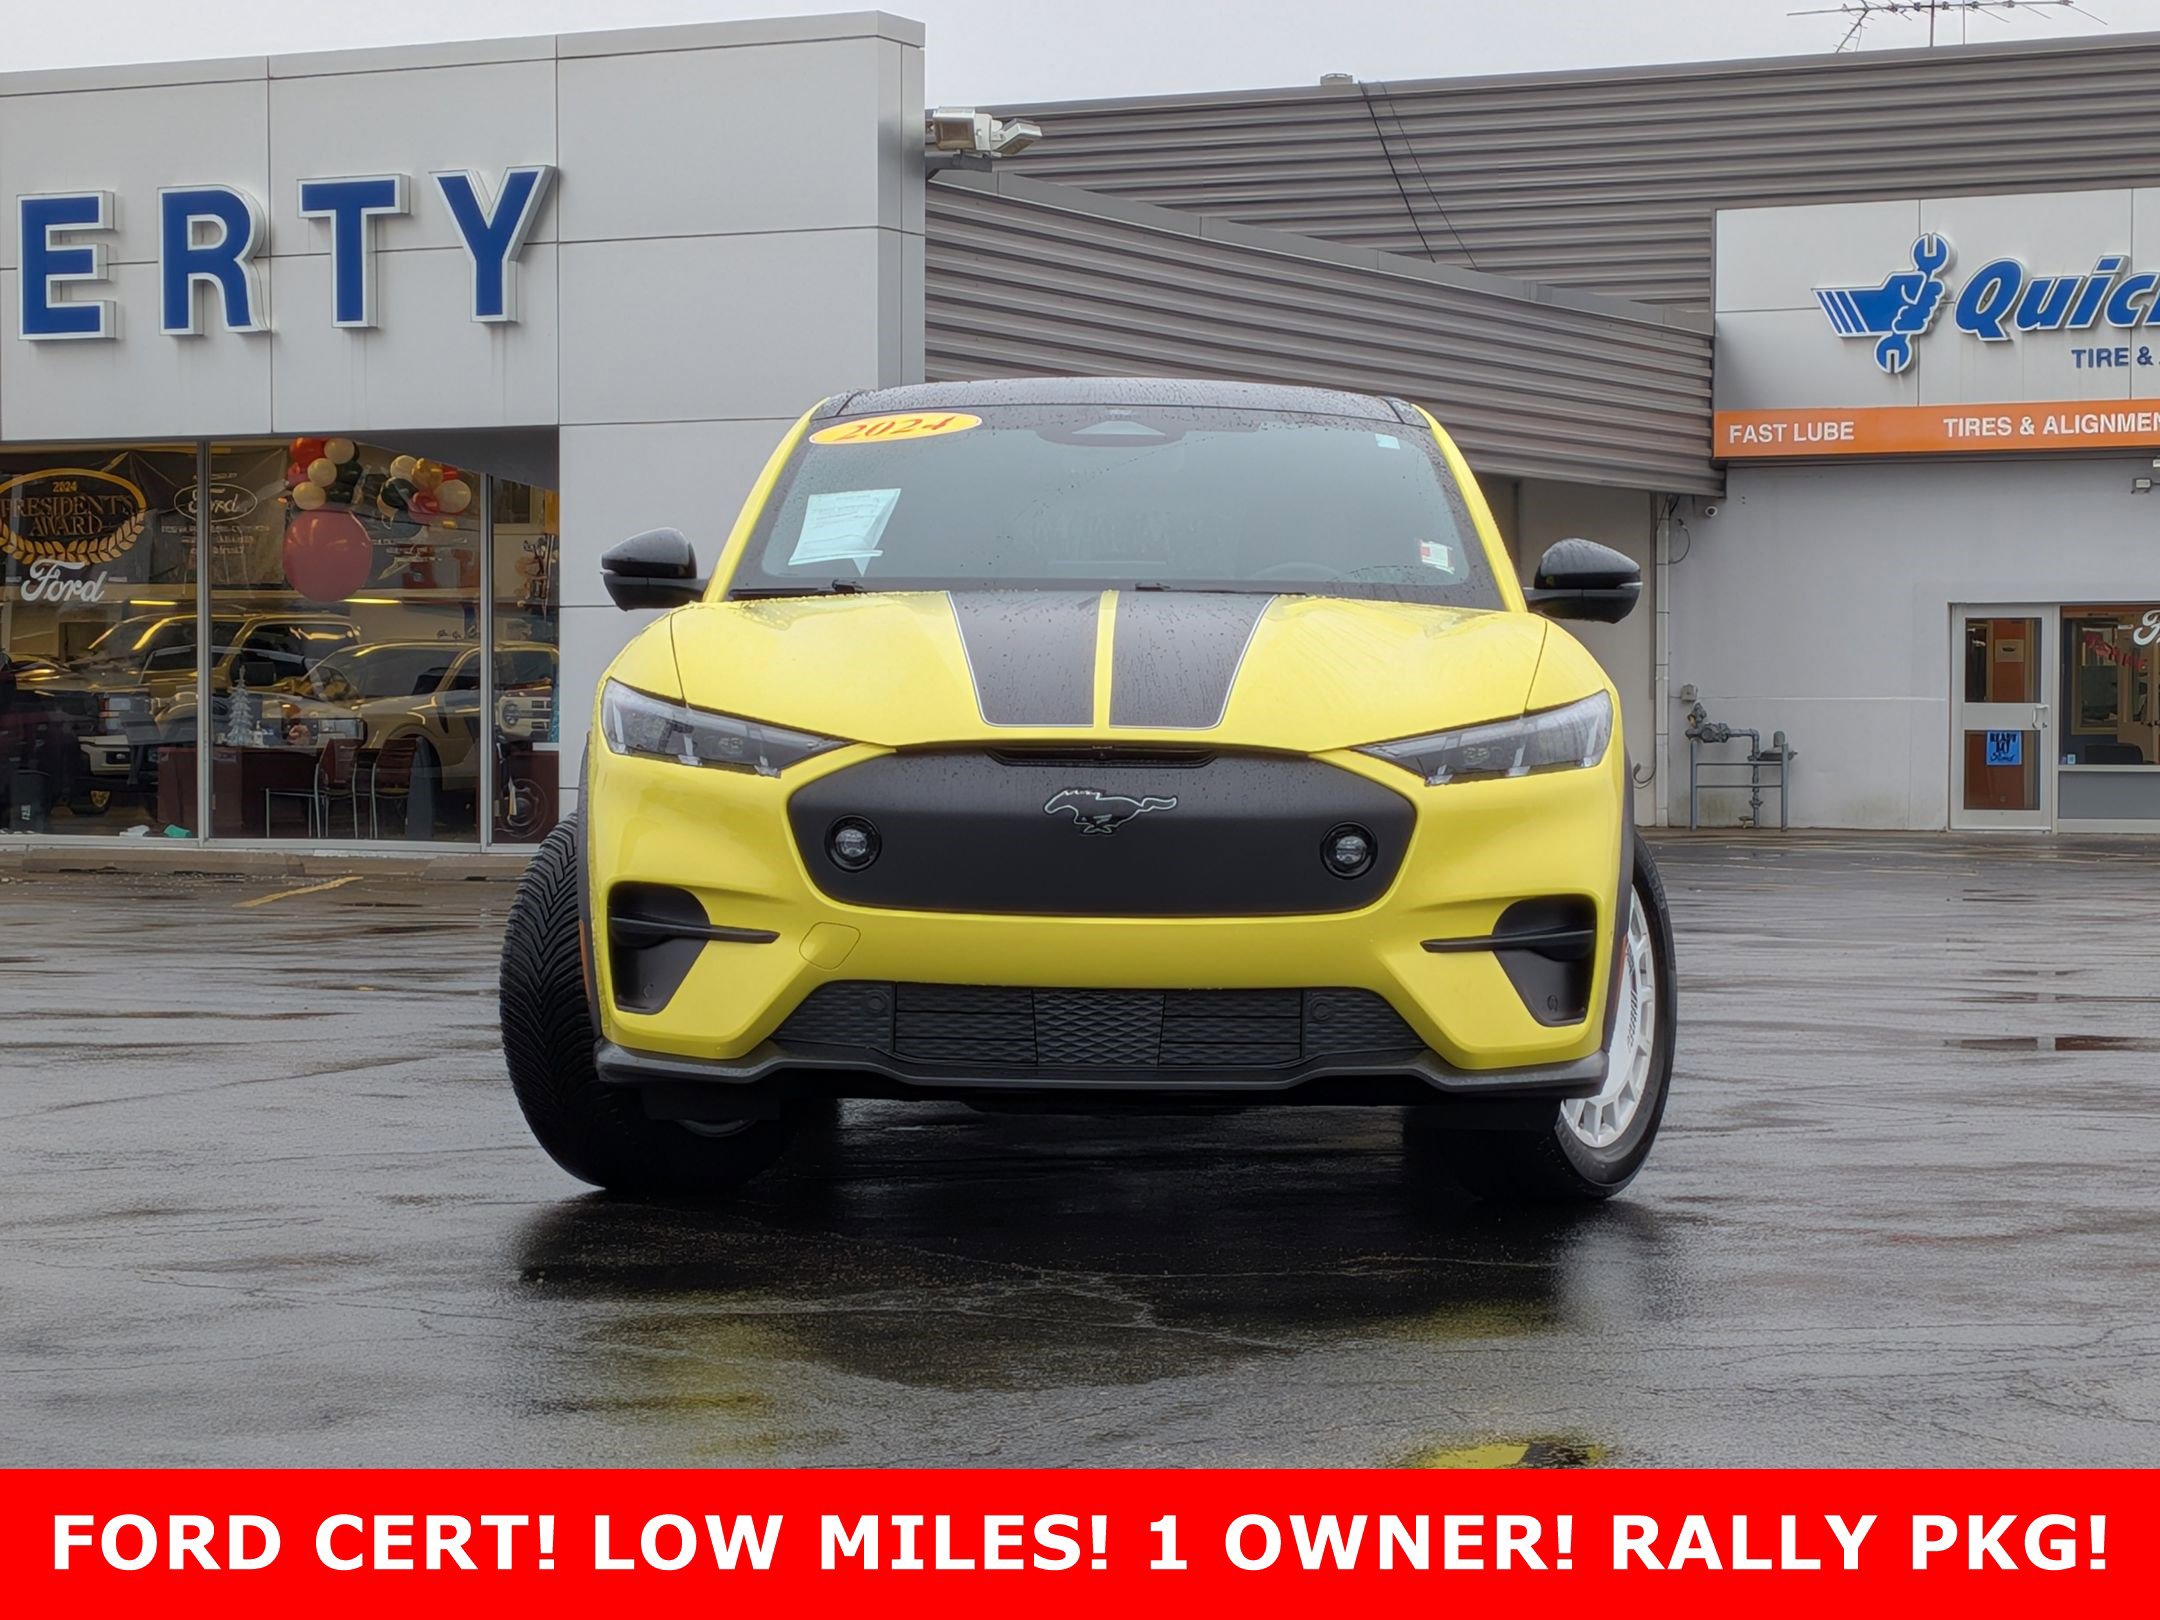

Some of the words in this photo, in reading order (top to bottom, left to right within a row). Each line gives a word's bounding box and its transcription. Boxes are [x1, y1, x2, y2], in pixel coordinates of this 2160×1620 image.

[17, 165, 555, 341] ERTY
[2072, 347, 2129, 369] TIRE
[2136, 346, 2153, 366] &
[832, 416, 957, 442] 2024
[1729, 423, 1787, 444] FAST
[1793, 421, 1854, 442] LUBE
[1943, 416, 2012, 438] TIRES
[2019, 416, 2035, 436] &
[52, 481, 79, 494] 2024
[29, 514, 104, 537] AWARD
[21, 558, 108, 602] Ford
